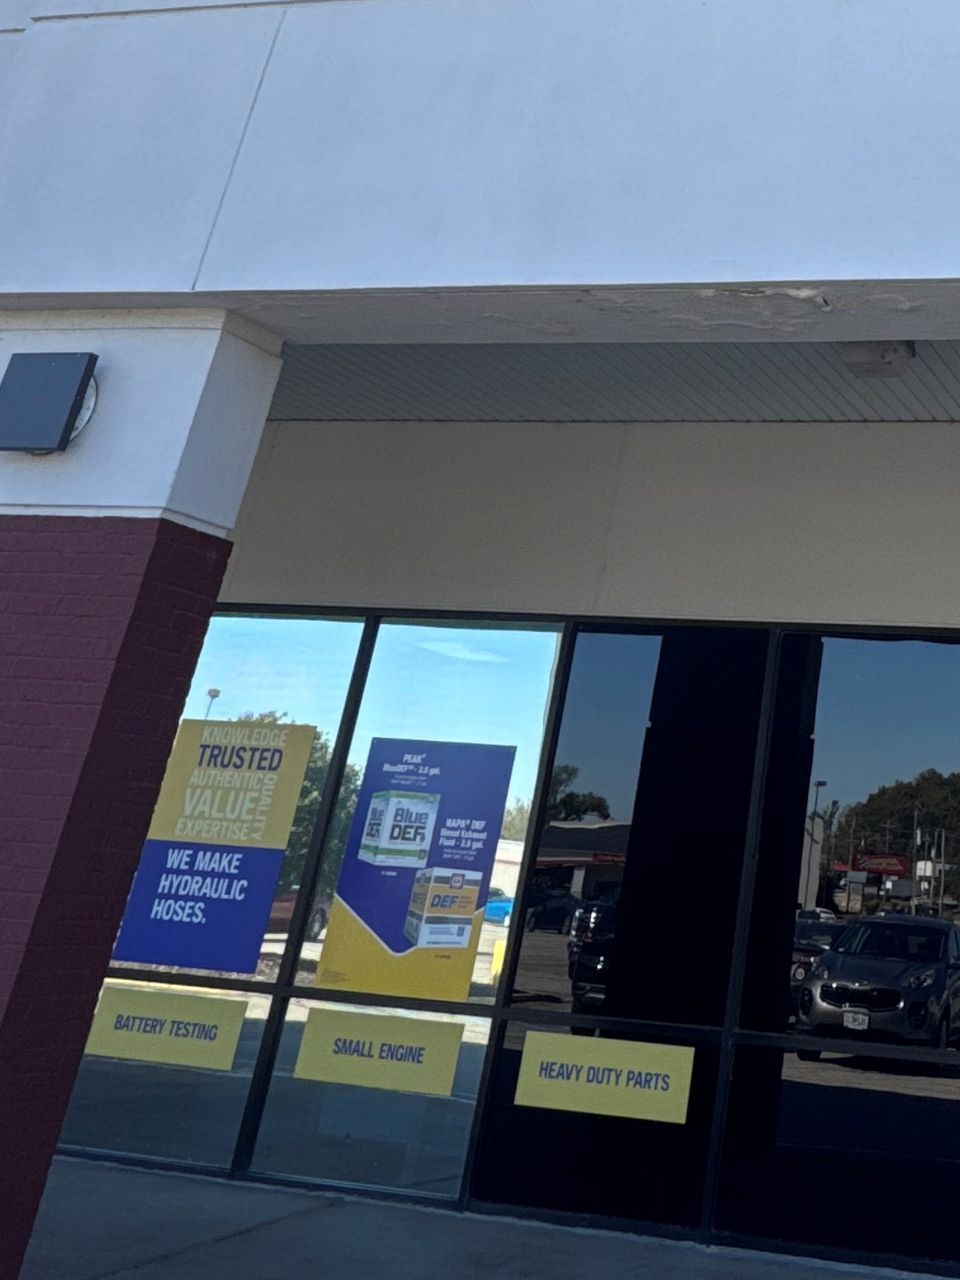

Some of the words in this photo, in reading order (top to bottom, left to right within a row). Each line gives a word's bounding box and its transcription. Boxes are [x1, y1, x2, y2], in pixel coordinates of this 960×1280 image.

[202, 726, 289, 746] KNOWLEDGE
[198, 744, 283, 771] TRUSTED
[190, 770, 264, 790] AUTHENTIC
[184, 788, 260, 820] VALUE
[251, 773, 278, 841] QUALITY
[394, 808, 429, 824] Blue
[176, 819, 250, 839] EXPERTISE
[166, 848, 194, 870] WE
[194, 849, 244, 874] MAKE
[158, 873, 248, 900] HYDRAULIC
[151, 899, 206, 924] HOSES.
[432, 895, 459, 908] DEF
[114, 1014, 167, 1036] BATTERY
[168, 1020, 219, 1041] TESTING
[333, 1038, 376, 1059] SMALL
[378, 1043, 426, 1064] ENGINE
[539, 1060, 584, 1082] HEAVY
[586, 1066, 624, 1087] DUTY
[626, 1069, 671, 1092] PARTS
